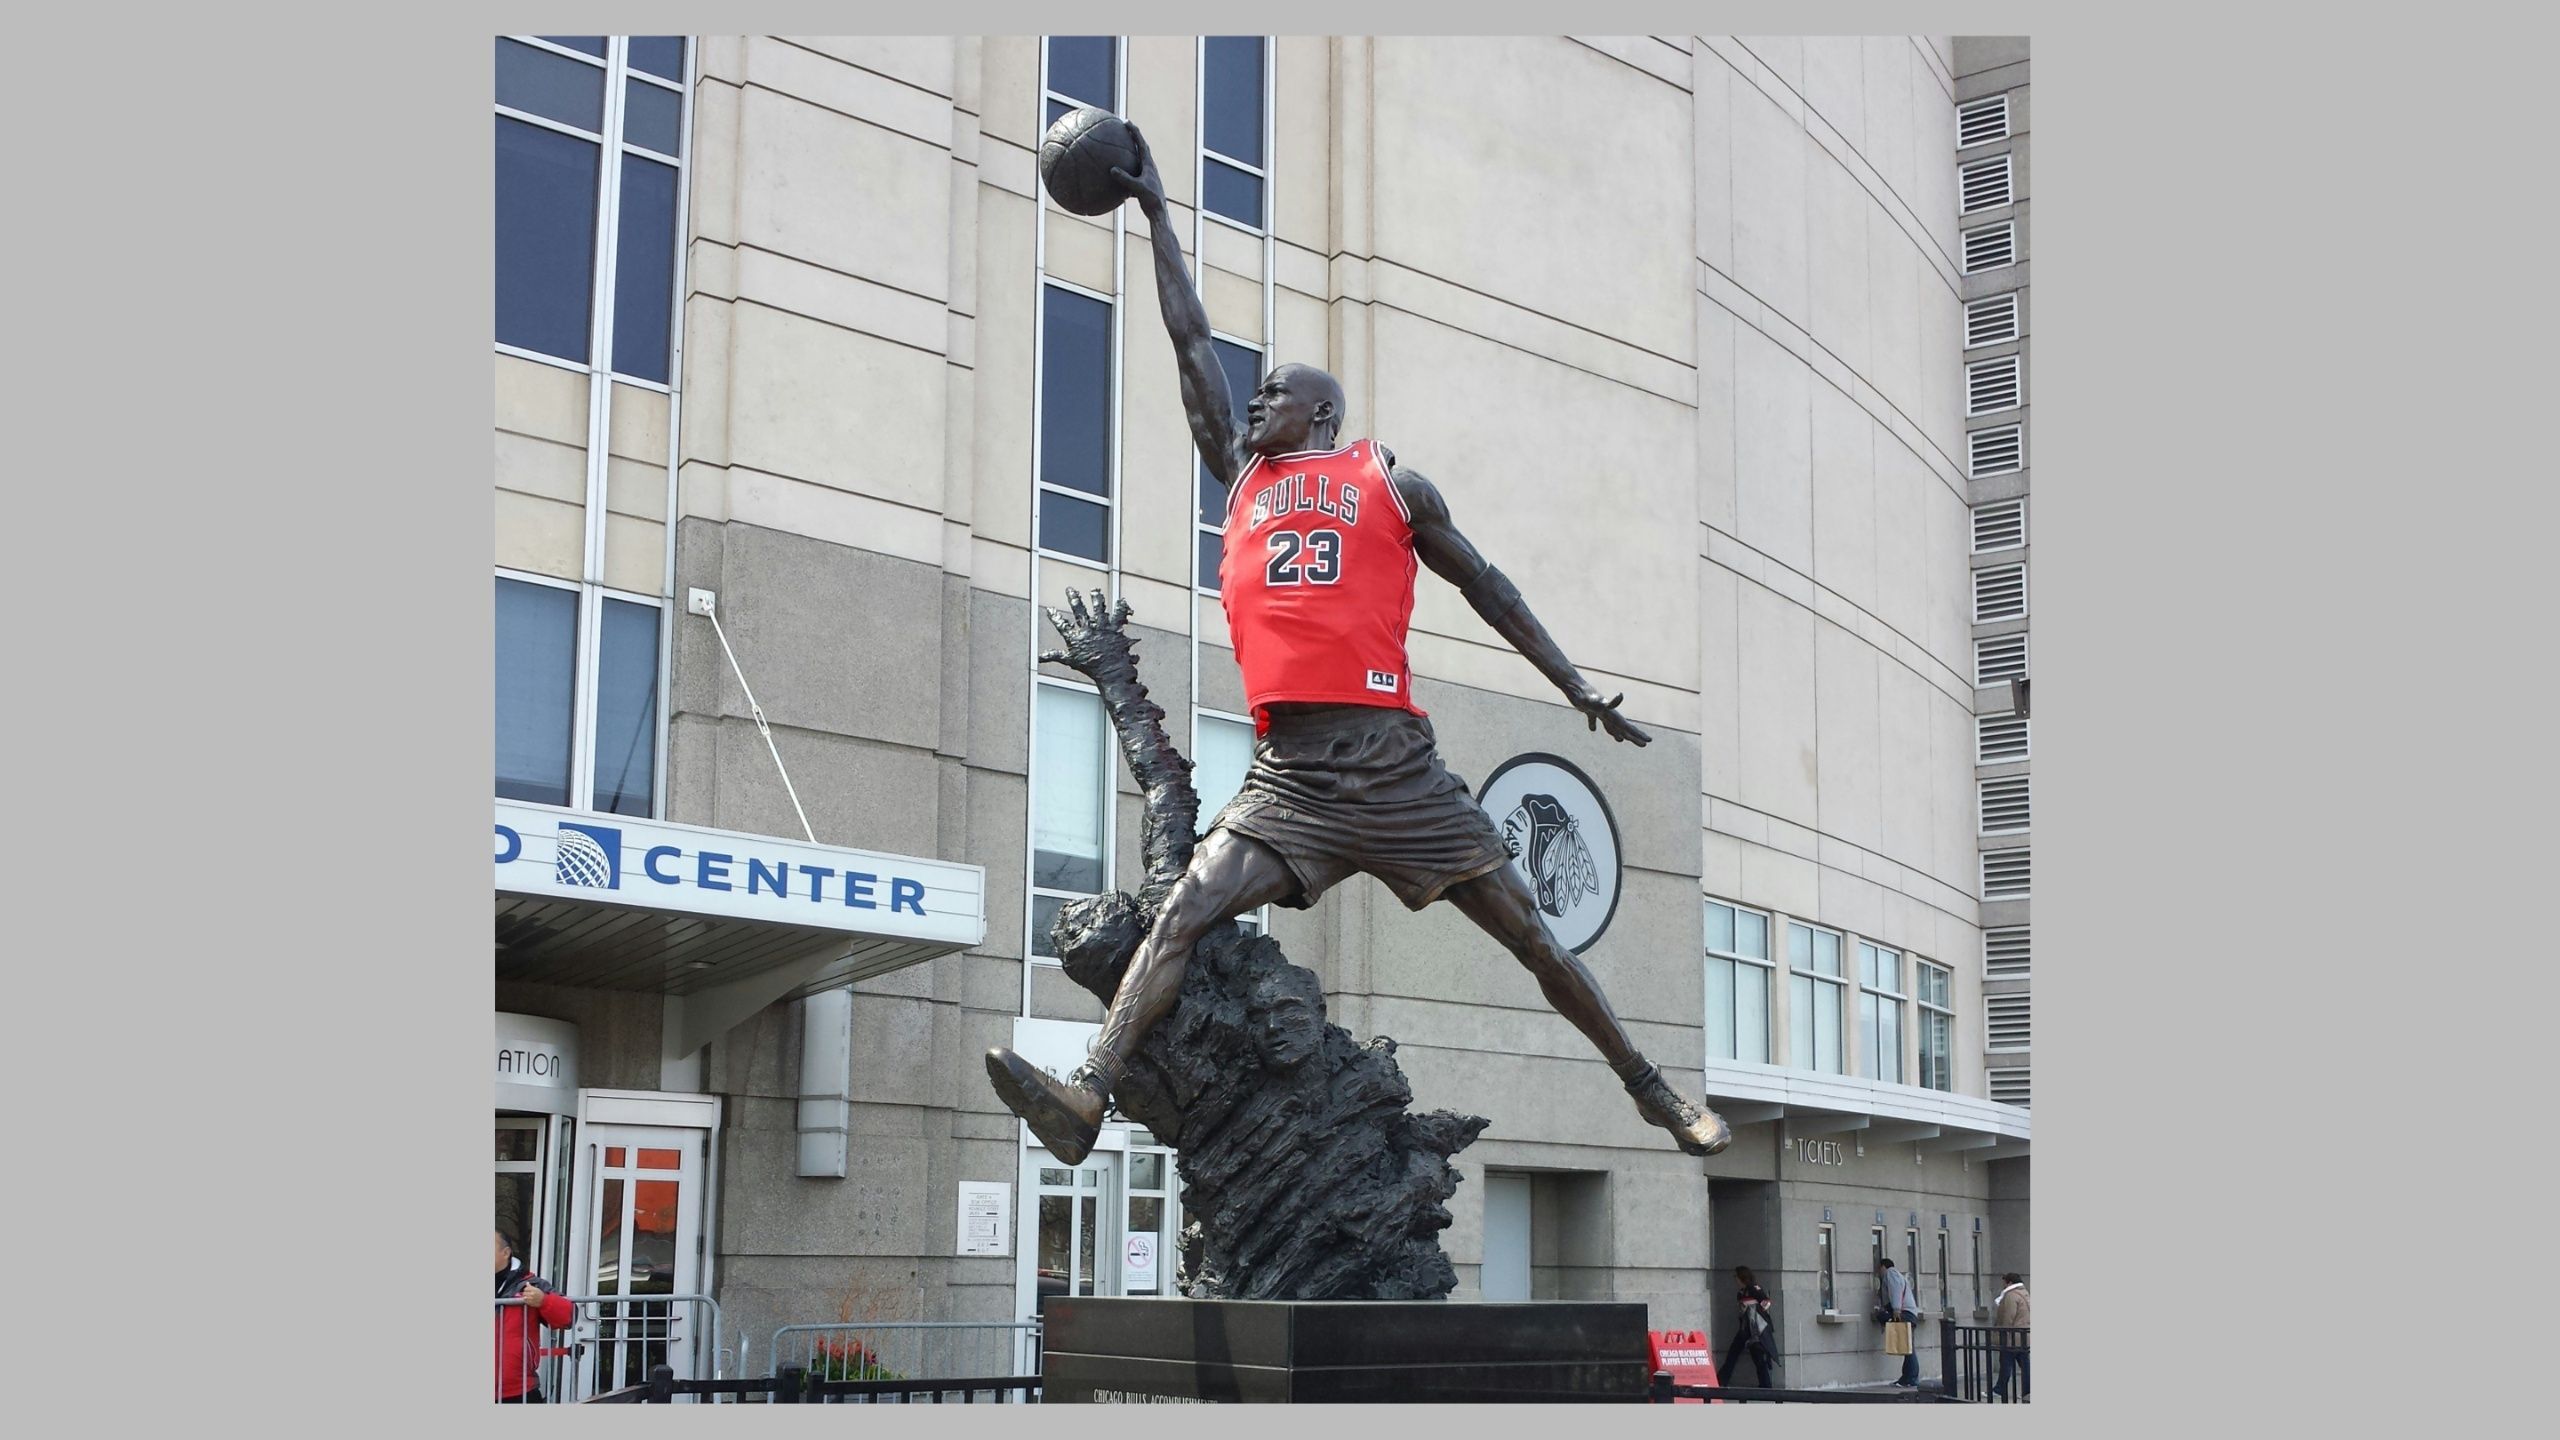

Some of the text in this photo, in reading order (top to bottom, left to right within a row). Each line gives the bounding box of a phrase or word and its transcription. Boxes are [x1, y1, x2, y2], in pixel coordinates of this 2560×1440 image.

[1250, 473, 1360, 530] BULLS
[1266, 529, 1342, 587] 23
[643, 845, 927, 917] CENTER
[1797, 1138, 1843, 1166] TICKETS
[1093, 1388, 1123, 1404] CHICAGO
